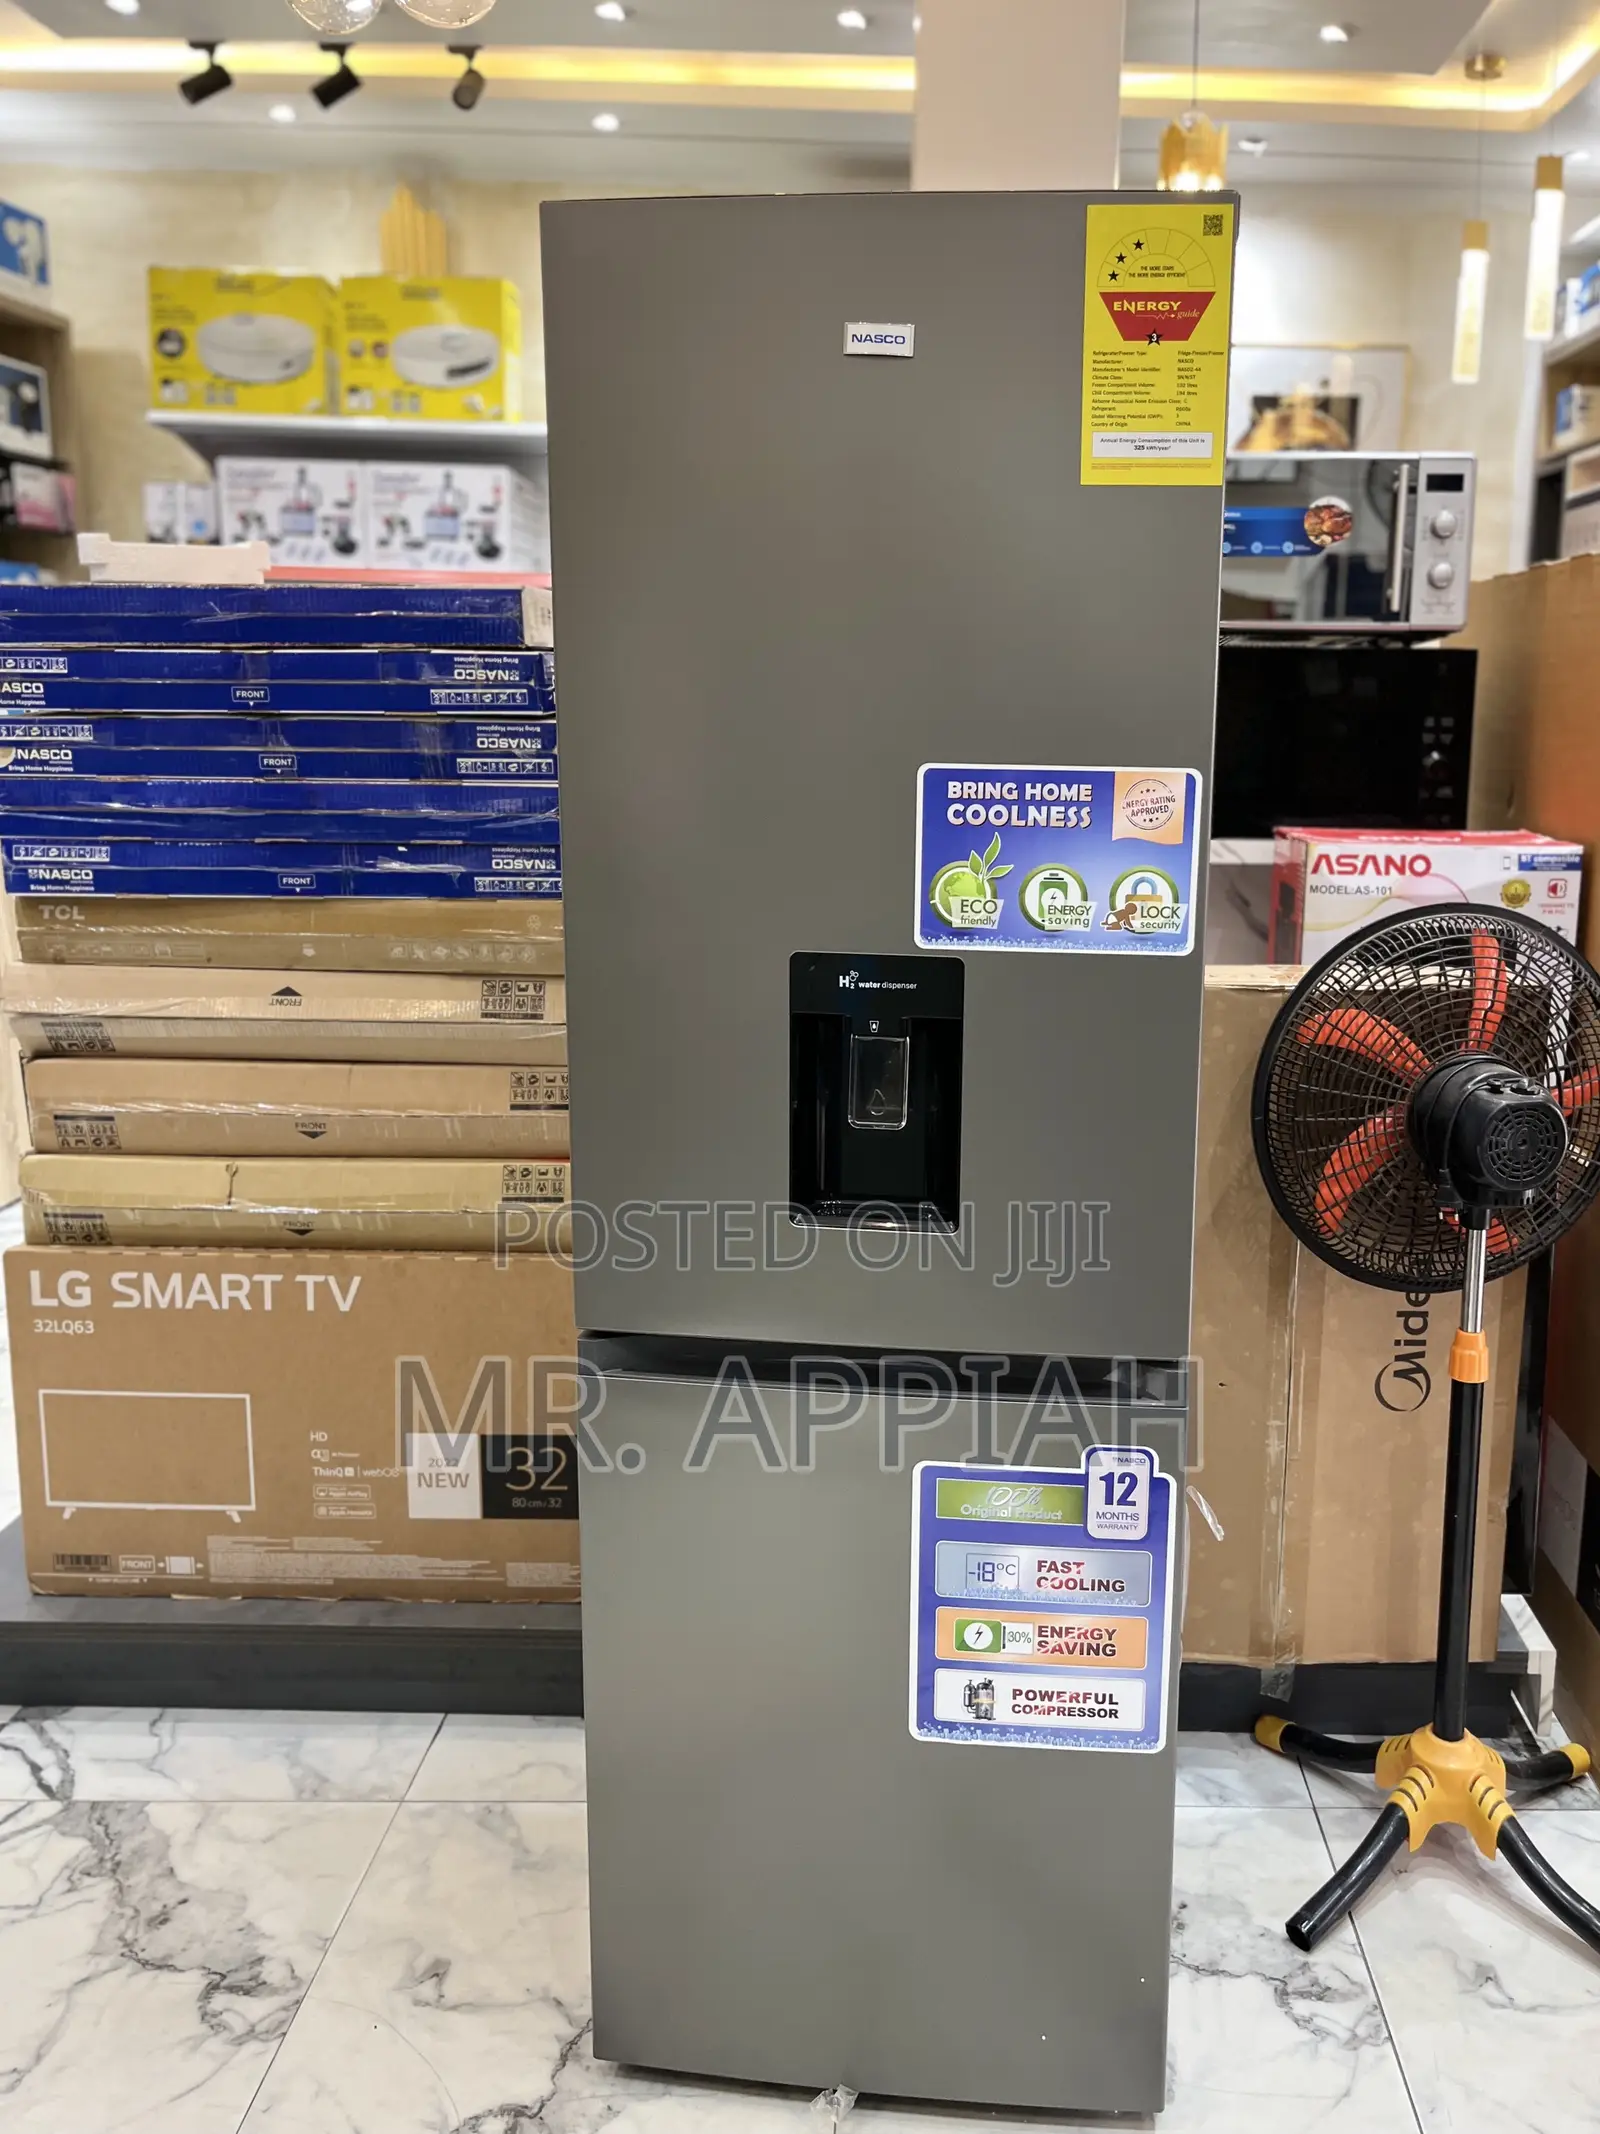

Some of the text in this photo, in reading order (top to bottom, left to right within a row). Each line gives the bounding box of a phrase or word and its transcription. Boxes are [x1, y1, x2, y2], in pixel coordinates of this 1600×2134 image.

[1113, 299, 1200, 320] ENERGY guide
[852, 334, 906, 344] NASCO
[1151, 333, 1157, 341] 3
[454, 669, 509, 681] NASCO
[1, 682, 44, 694] ASCO
[236, 690, 265, 698] FRONT
[476, 738, 531, 748] NASCO
[17, 749, 72, 760] NASCO
[263, 758, 292, 766] FRONT
[947, 781, 1093, 803] BRING HOME
[1122, 794, 1176, 810] ENERGY RATING
[946, 804, 1093, 829] COOLNESS
[1130, 804, 1170, 818] APPROVED
[492, 858, 546, 870] NASCO
[1310, 854, 1432, 878] ASANO
[38, 869, 94, 880] NASCO
[38, 904, 85, 921] TCL
[960, 899, 998, 914] ECO
[1047, 904, 1093, 917] ENERGY
[1140, 905, 1181, 920] LOCK
[960, 916, 997, 928] friendly
[1048, 915, 1090, 928] saving
[1140, 919, 1181, 931] security
[881, 981, 918, 990] dispenser
[268, 998, 302, 1007] FRONT
[29, 1270, 362, 1313] LG SMART TV
[33, 1319, 95, 1335] 32LQ63
[310, 1431, 328, 1442] HD
[428, 1458, 459, 1468] 2022
[505, 1446, 568, 1491] 32
[312, 1466, 344, 1478] ThinQ
[362, 1467, 400, 1478] webOS
[418, 1472, 469, 1489] NEW
[987, 1483, 1043, 1505] 100%
[1099, 1472, 1138, 1506] 12
[960, 1502, 1063, 1521] Original Product
[1096, 1511, 1140, 1521] MONTHS
[122, 1560, 152, 1568] FRONT
[1037, 1559, 1085, 1575] FAST
[1036, 1576, 1126, 1593] COOLING
[1007, 1630, 1032, 1644] 30%
[1037, 1625, 1117, 1642] ENERGY
[1036, 1640, 1117, 1657] SAVING
[1012, 1688, 1119, 1706] POWERFUL
[1011, 1704, 1119, 1720] COMPRESSOR
